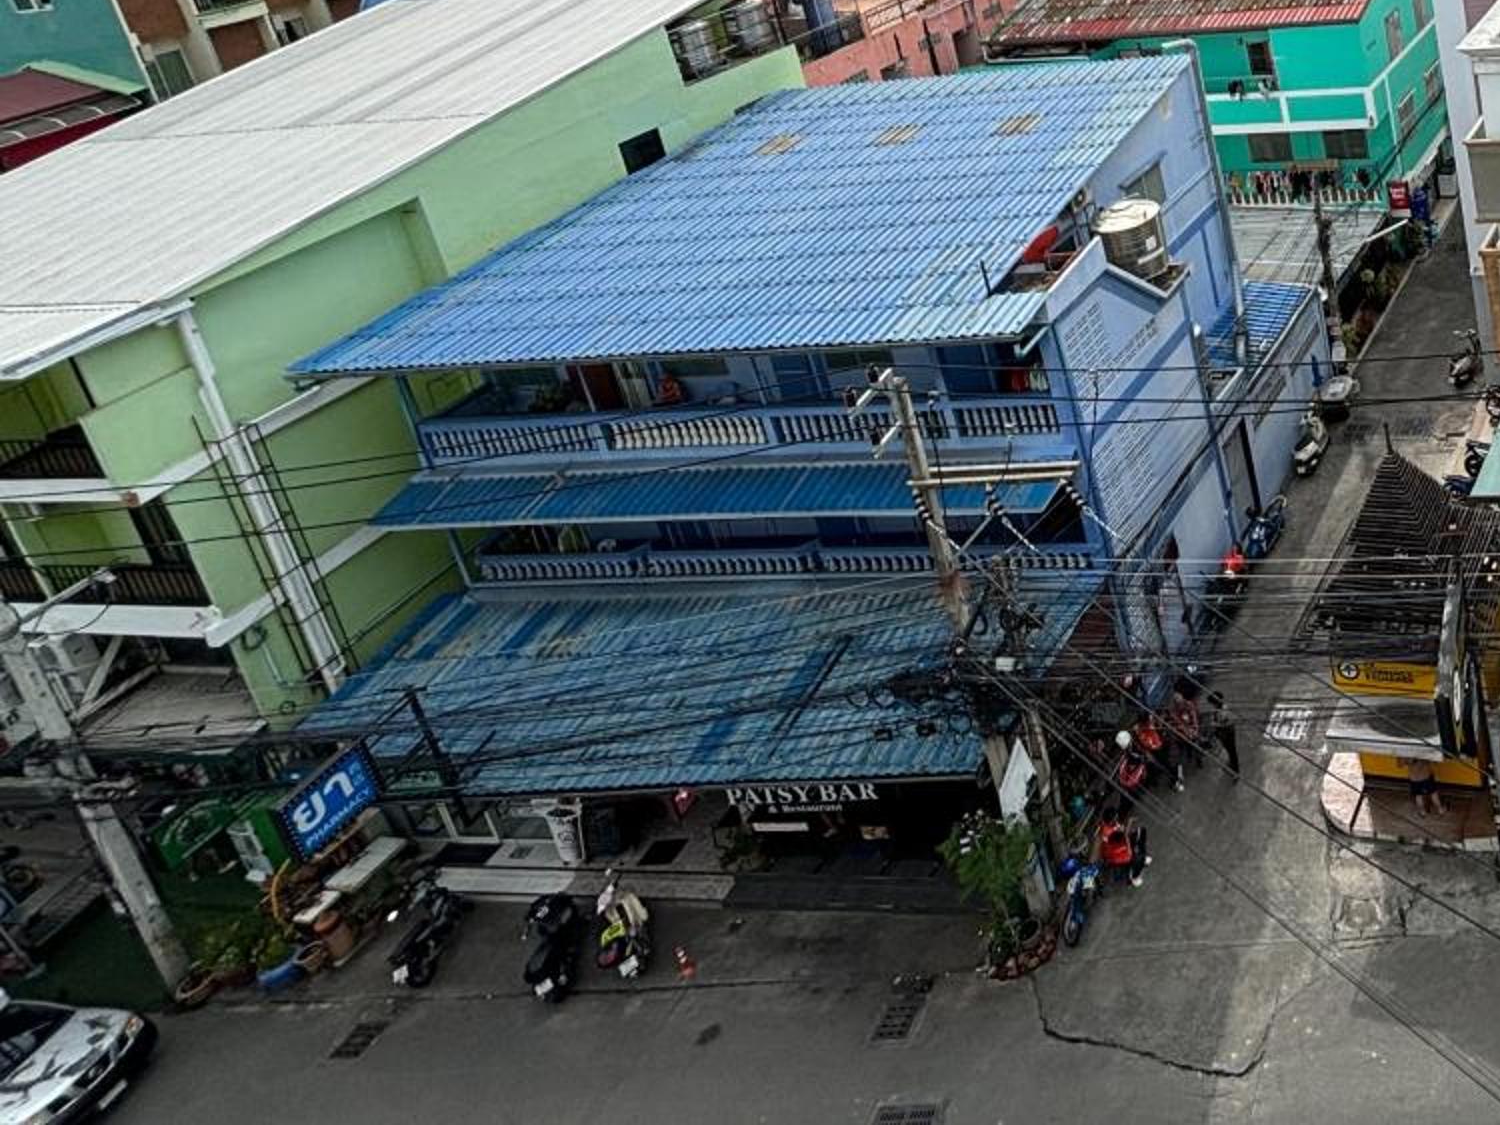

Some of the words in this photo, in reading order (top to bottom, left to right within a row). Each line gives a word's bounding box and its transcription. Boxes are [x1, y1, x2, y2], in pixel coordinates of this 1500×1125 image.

[292, 771, 355, 833] ยา
[305, 786, 371, 850] PHARMACY
[725, 785, 809, 806] PATSY
[819, 782, 879, 802] BAR
